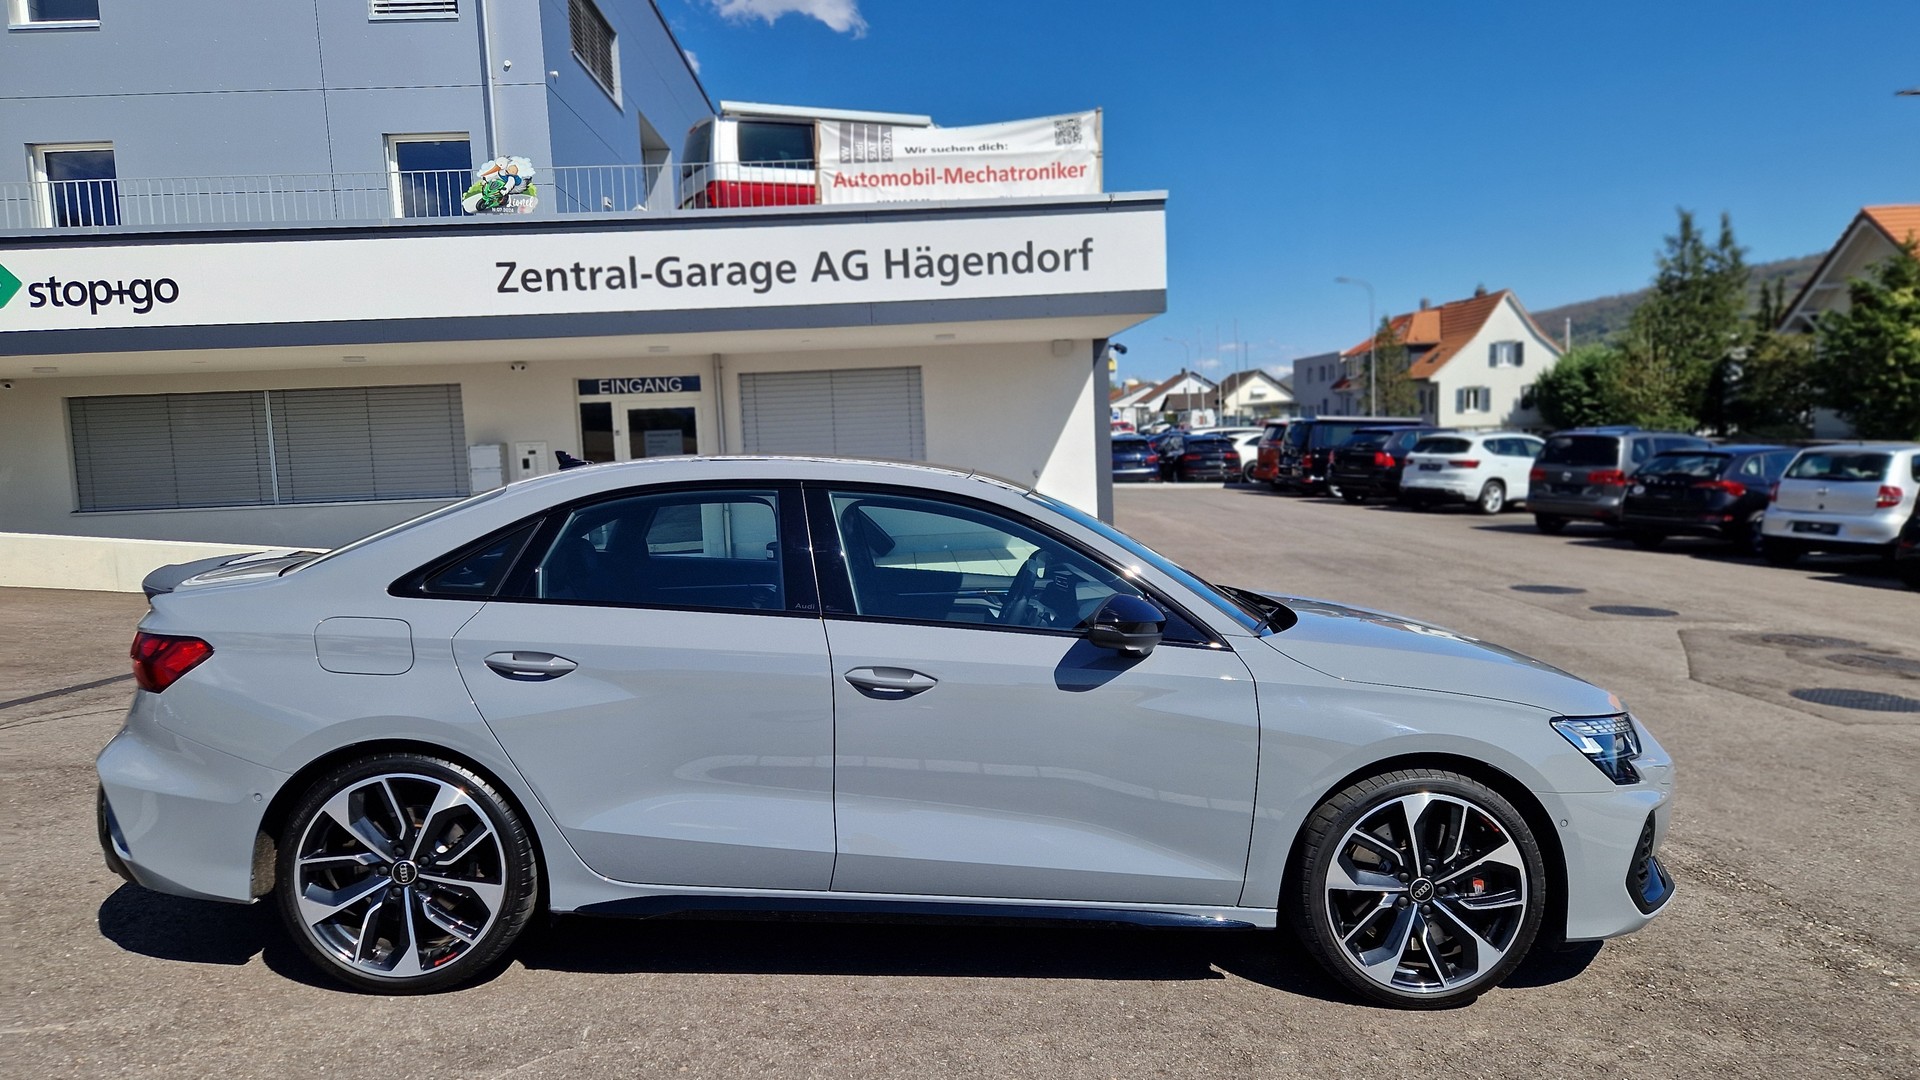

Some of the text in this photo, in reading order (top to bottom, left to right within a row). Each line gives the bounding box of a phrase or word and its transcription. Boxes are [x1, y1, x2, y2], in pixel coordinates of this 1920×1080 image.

[856, 141, 864, 160] Audi
[905, 142, 1009, 155] Wir suchen dich:
[833, 162, 1087, 188] Automobil-Mechatroniker
[495, 237, 1094, 294] Zentral-Garage AG Hägendorf
[28, 275, 179, 315] stop+go
[599, 377, 682, 394] EINGANG
